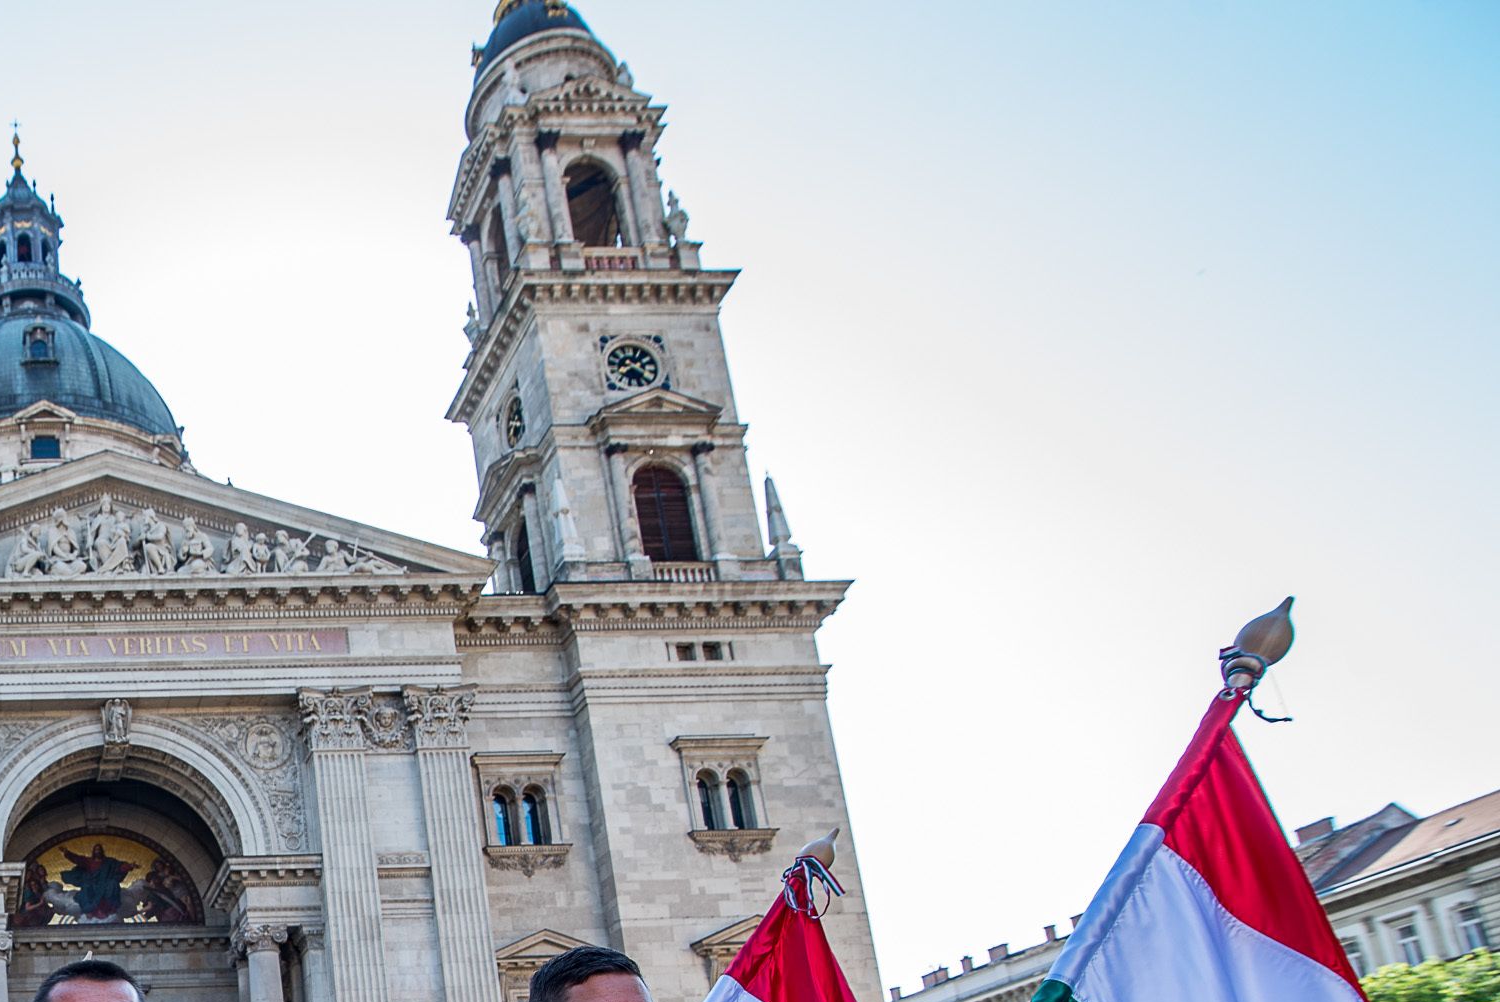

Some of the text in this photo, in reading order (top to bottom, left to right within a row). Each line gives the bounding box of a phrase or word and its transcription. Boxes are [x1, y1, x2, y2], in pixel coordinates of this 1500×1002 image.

[46, 638, 90, 657] VIA
[106, 636, 208, 655] VERITAS
[223, 634, 252, 653] ET
[267, 633, 322, 653] VITA
